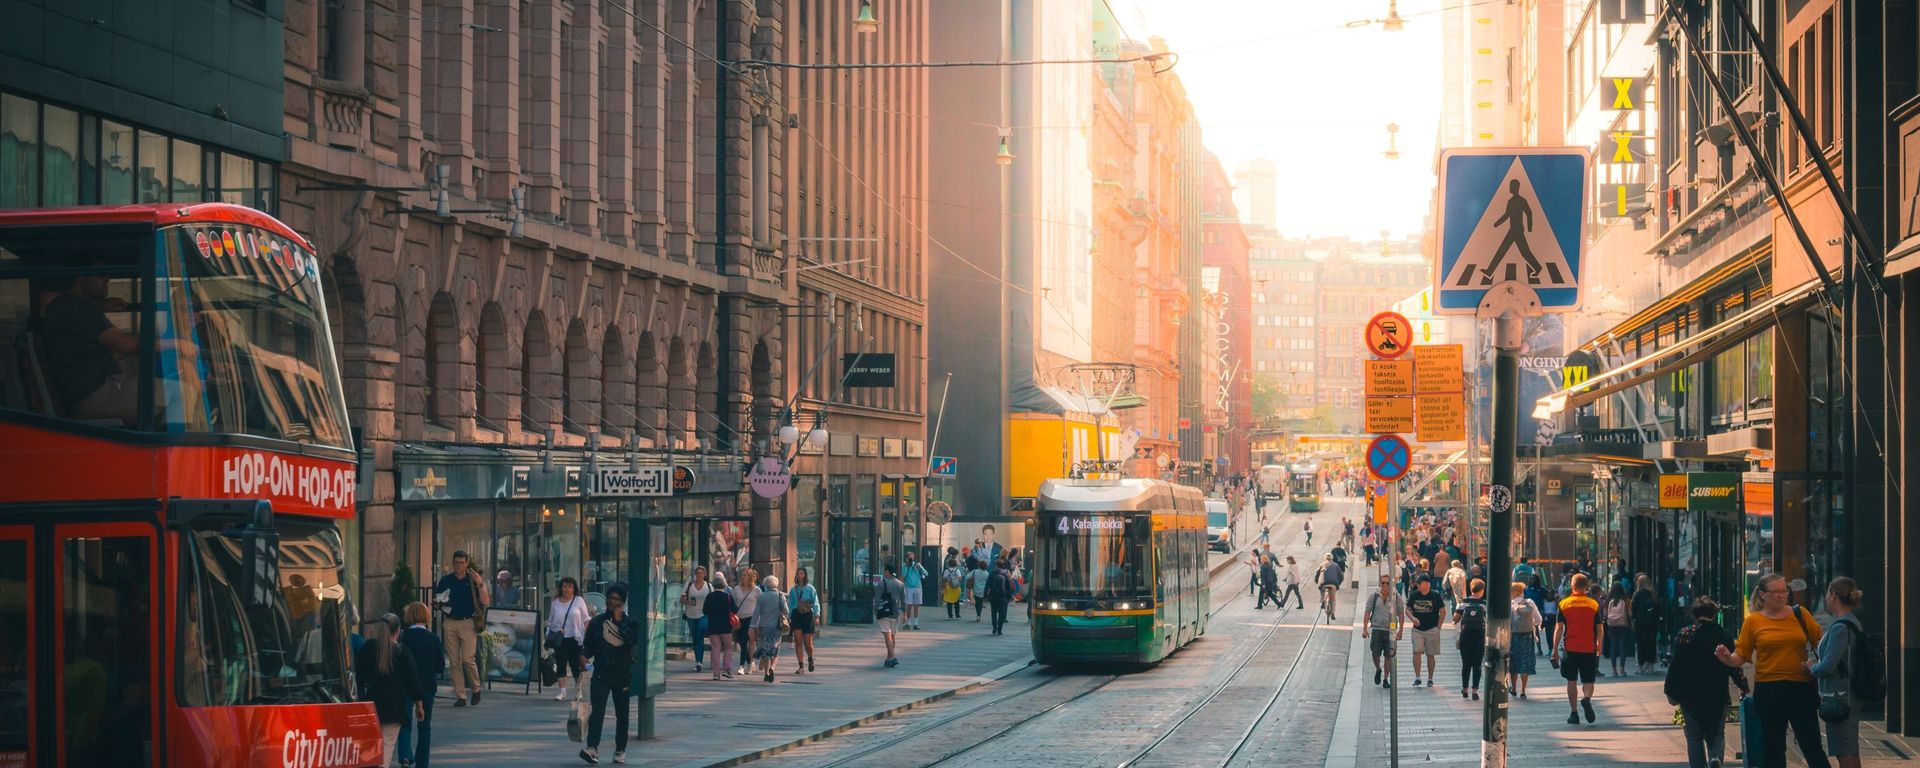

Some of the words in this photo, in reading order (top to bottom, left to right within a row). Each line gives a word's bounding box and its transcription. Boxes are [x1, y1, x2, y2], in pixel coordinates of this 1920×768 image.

[223, 453, 295, 496] HOP-ON
[298, 465, 356, 509] HOP-OFF
[606, 475, 656, 488] Wolford
[1690, 486, 1734, 497] SUBWAY
[1058, 516, 1069, 535] 4
[1072, 518, 1123, 531] Katajanokka
[283, 729, 360, 768] CityTour.fi
